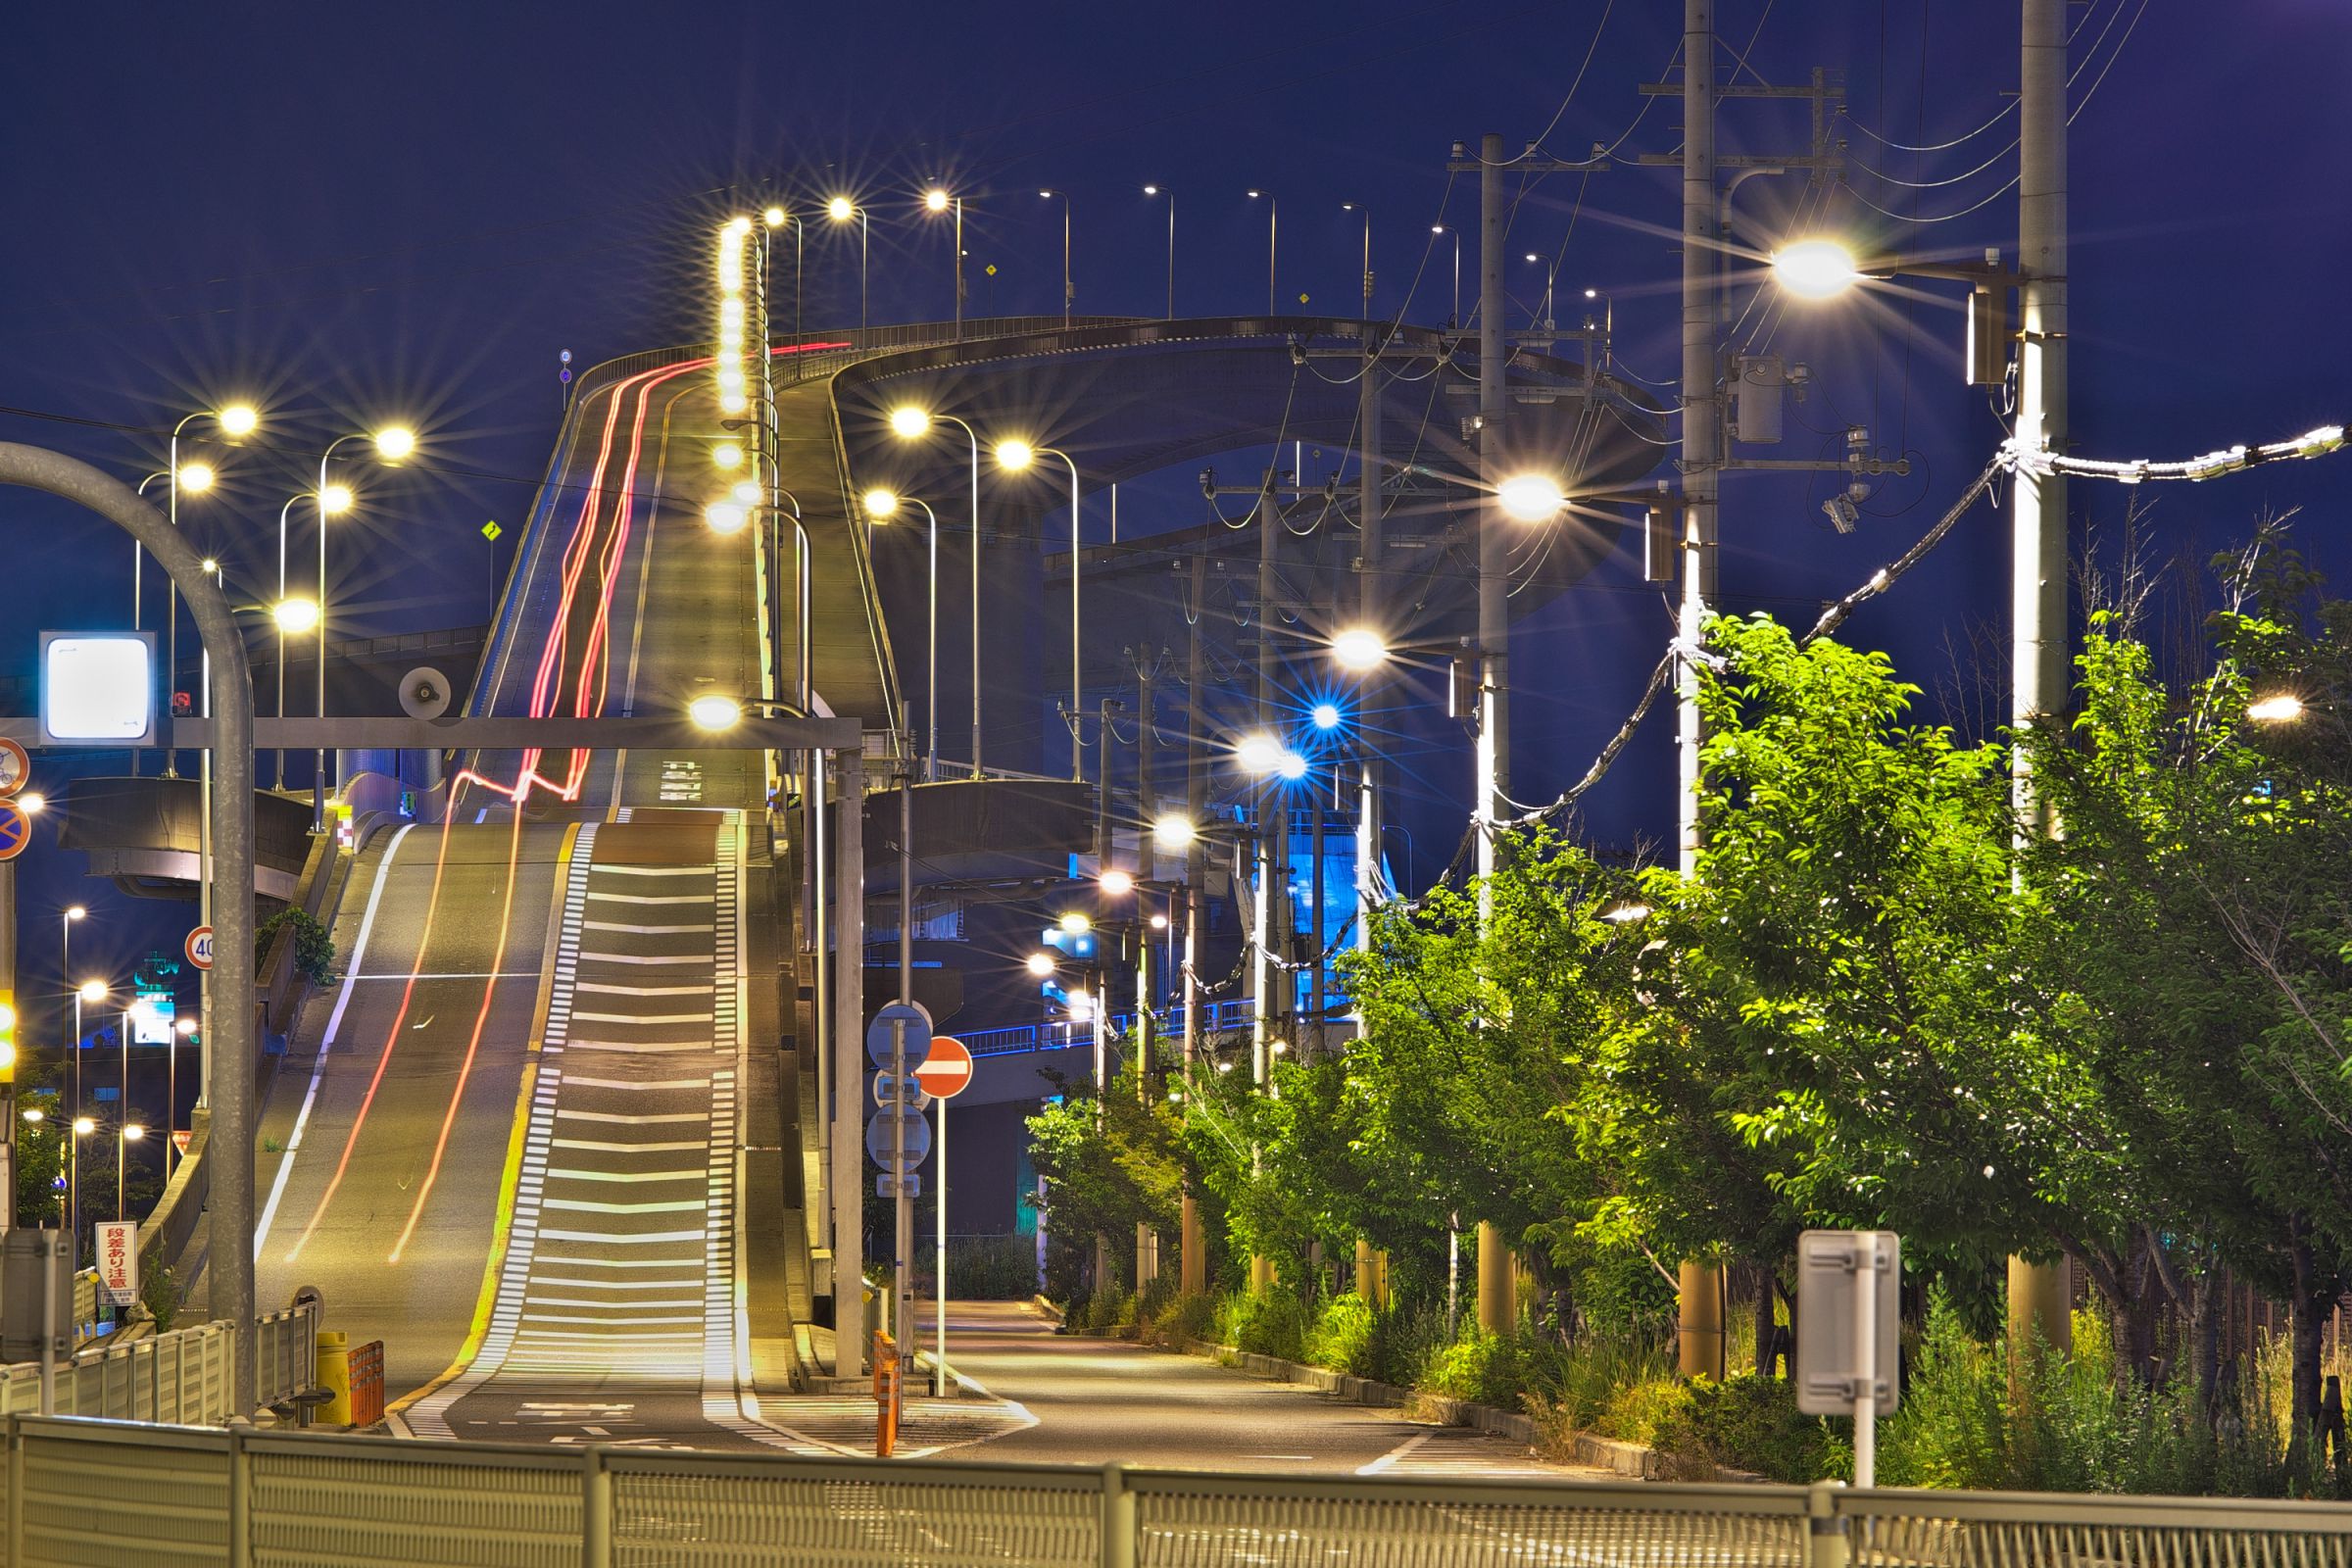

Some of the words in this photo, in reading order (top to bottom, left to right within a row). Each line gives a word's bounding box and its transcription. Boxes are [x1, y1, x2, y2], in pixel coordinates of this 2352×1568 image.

[195, 938, 213, 956] 40
[107, 1228, 126, 1289] 段差あり注意
